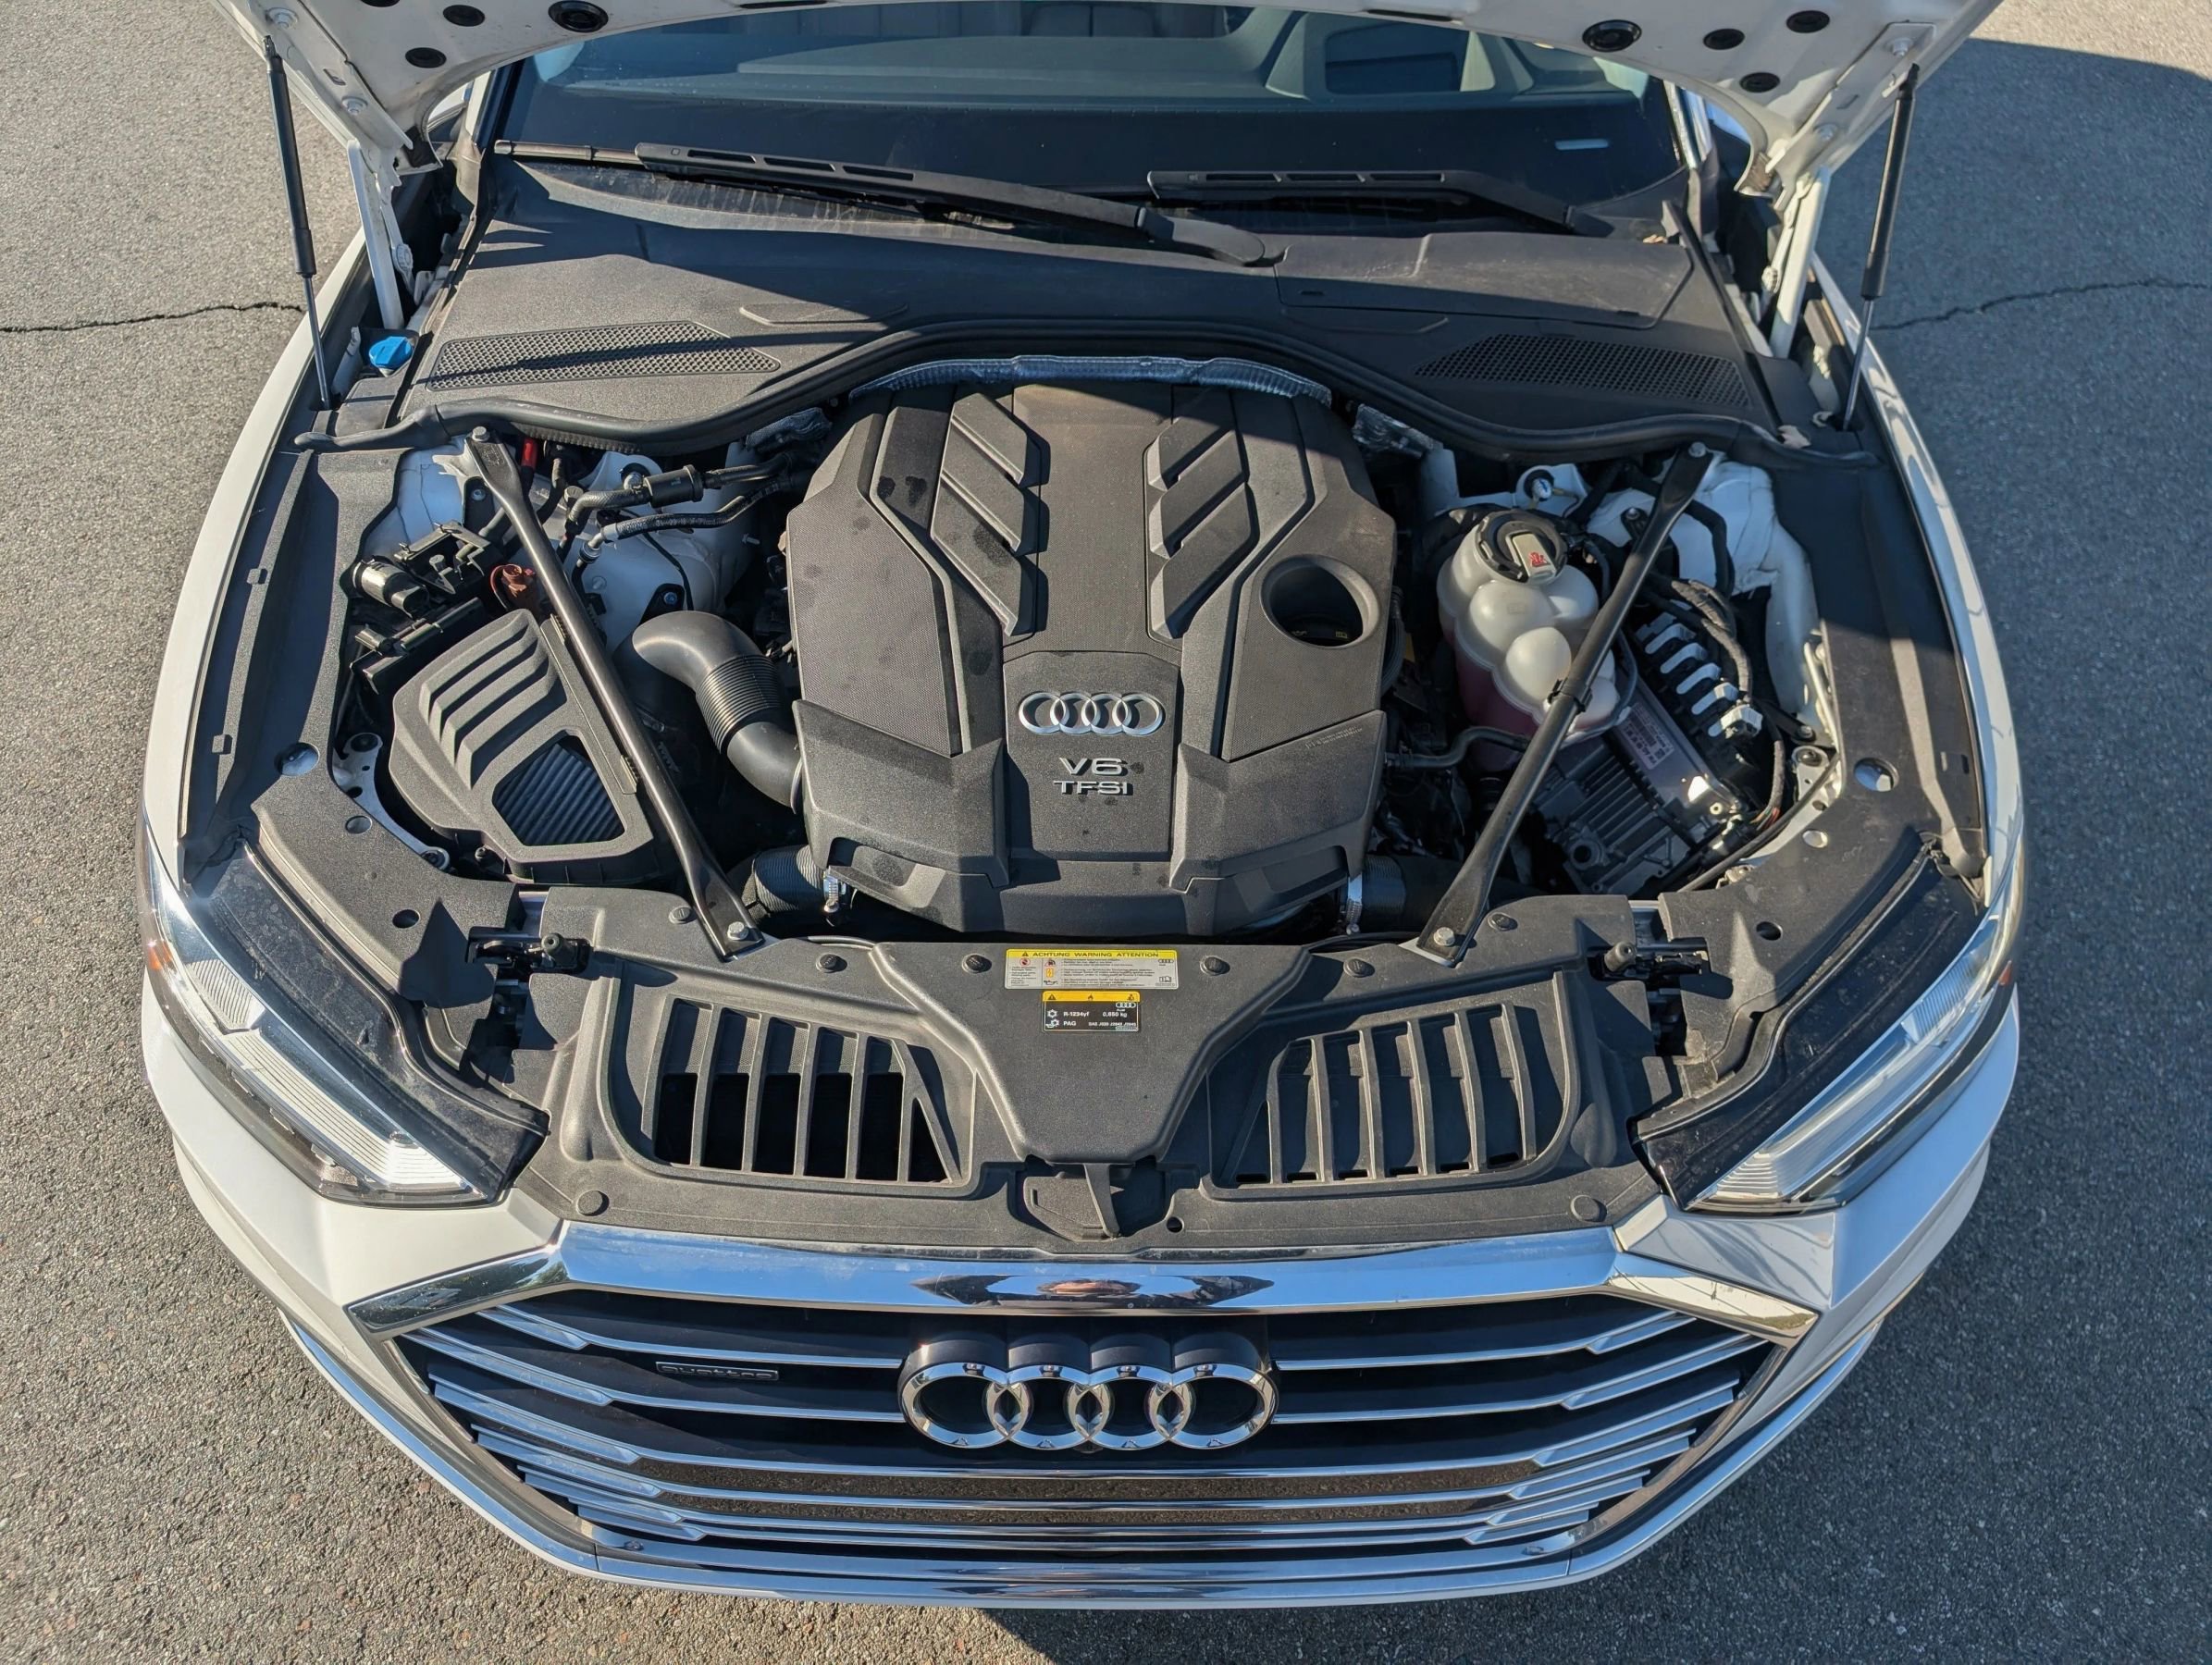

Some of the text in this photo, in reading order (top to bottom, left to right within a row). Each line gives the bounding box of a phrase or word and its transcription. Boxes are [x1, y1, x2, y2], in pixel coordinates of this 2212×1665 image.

[1058, 757, 1123, 776] V6
[1053, 781, 1128, 796] TFSI
[661, 1365, 772, 1379] quattro
